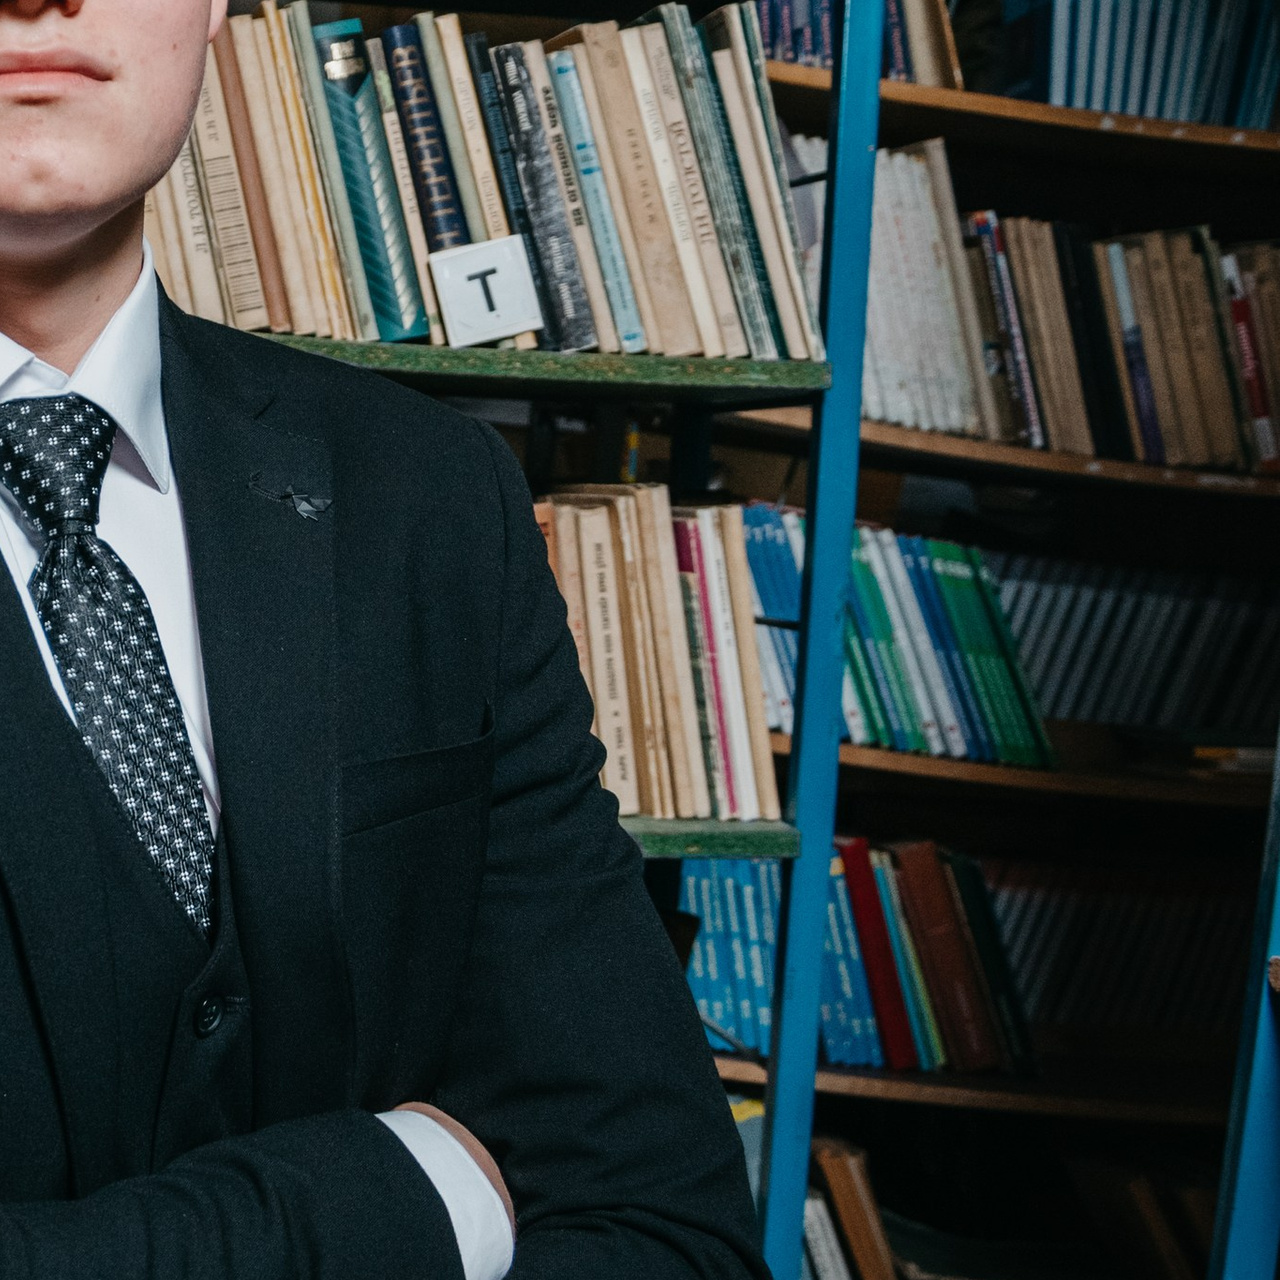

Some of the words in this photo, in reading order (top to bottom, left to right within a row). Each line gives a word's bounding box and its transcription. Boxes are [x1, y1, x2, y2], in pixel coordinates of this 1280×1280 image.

[455, 77, 477, 131] МОЛЬЕР
[540, 86, 561, 129] черте
[640, 88, 666, 142] МОЛЬЕР
[179, 147, 205, 218] ТОЛСТОЙ
[551, 133, 581, 204] огненной
[670, 121, 705, 206] ТОЛСТОЙ
[480, 171, 505, 234] КОРНЕЛЬ
[571, 207, 585, 227] на
[667, 180, 692, 241] КОРНЕЛЬ
[466, 267, 498, 313] Т
